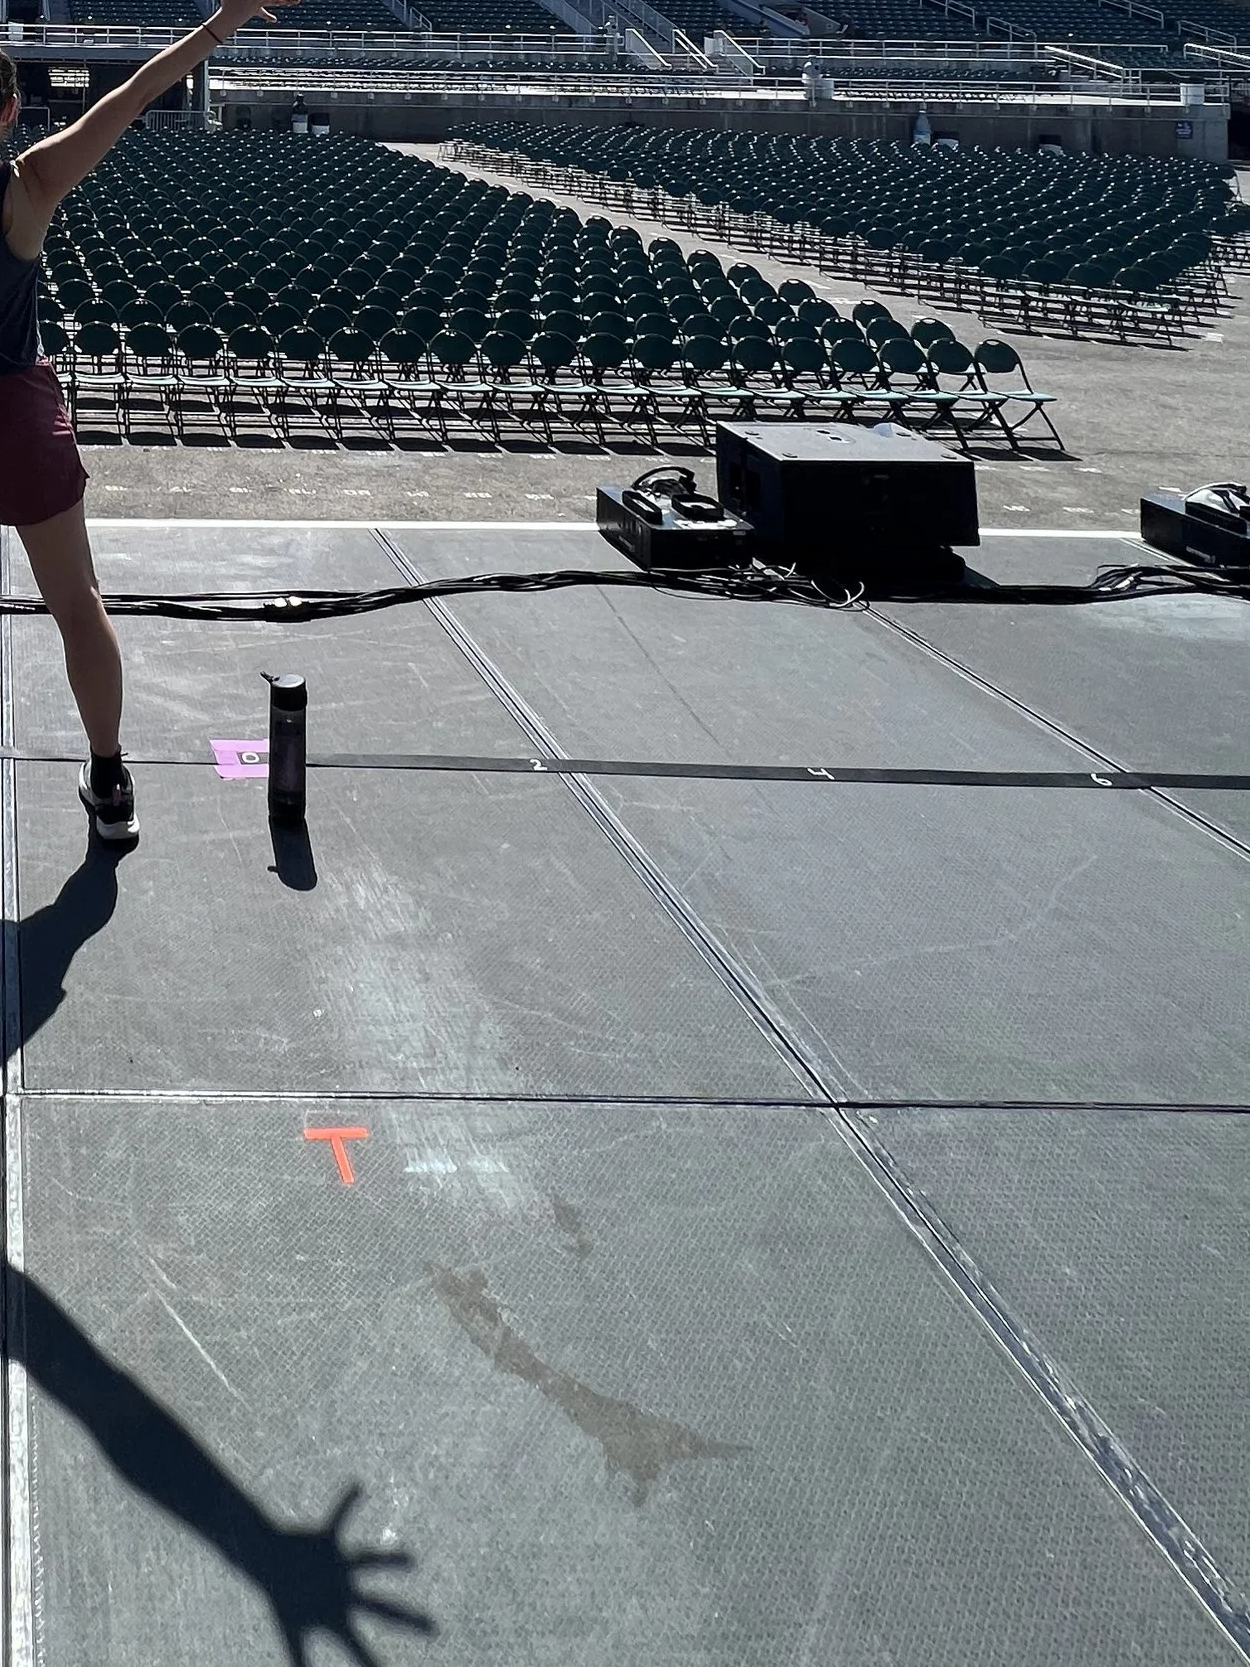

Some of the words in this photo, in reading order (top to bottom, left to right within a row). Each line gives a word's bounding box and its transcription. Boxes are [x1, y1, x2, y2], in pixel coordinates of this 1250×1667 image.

[529, 758, 548, 771] 2
[806, 767, 835, 781] 4
[1090, 773, 1113, 786] 6
